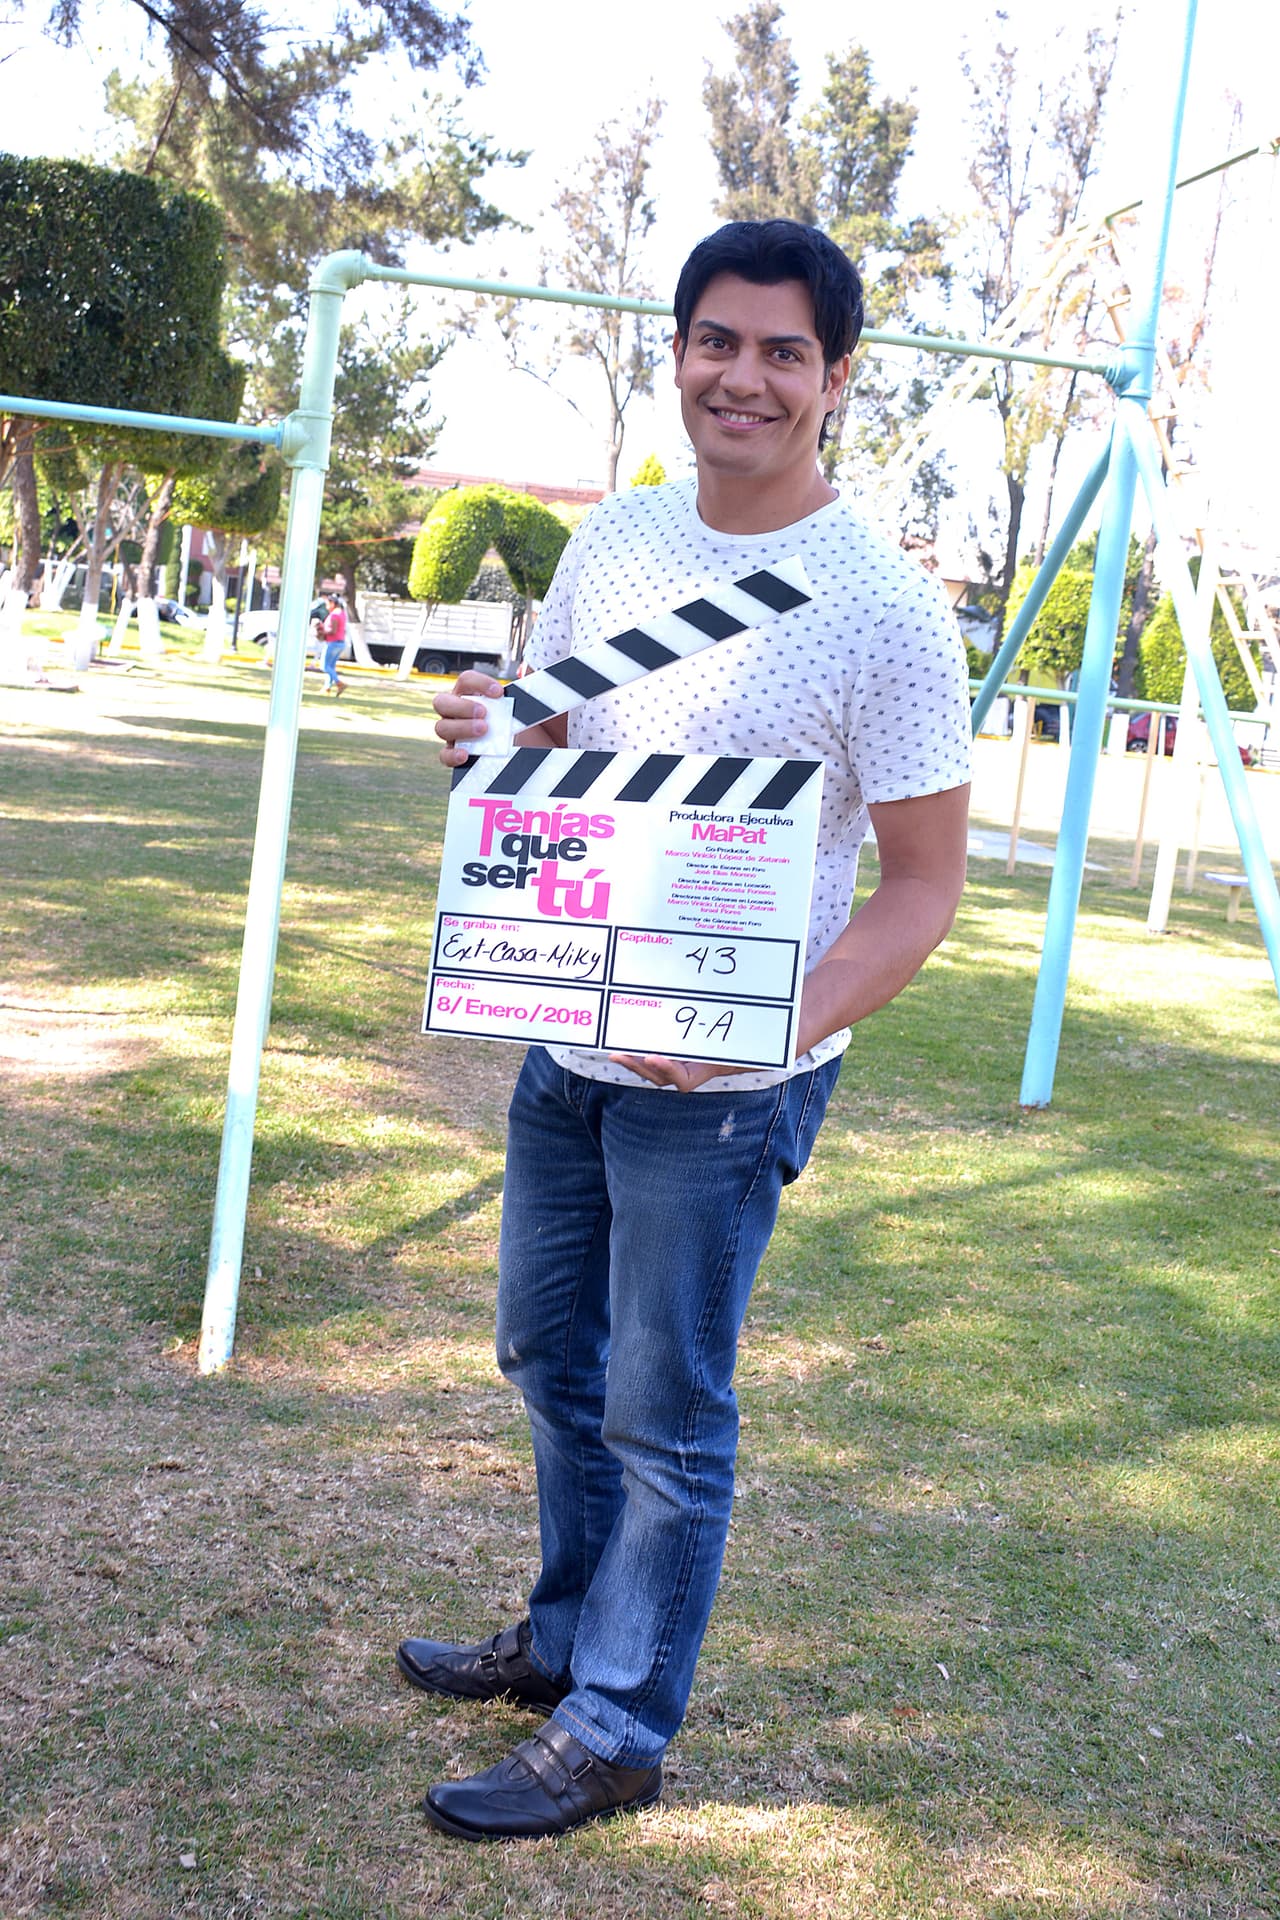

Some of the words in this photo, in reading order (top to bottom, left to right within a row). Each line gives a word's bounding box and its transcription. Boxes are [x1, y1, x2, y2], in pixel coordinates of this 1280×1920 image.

[670, 810, 734, 822] Productora
[740, 814, 794, 826] Ejecutiva
[469, 799, 615, 856] Tenías
[692, 823, 767, 844] MaPat
[501, 833, 587, 865] que
[719, 854, 742, 862] López
[461, 863, 537, 889] ser
[531, 861, 611, 919] tú
[443, 918, 461, 928] Se
[464, 920, 497, 932] graba
[501, 922, 520, 932] en:
[619, 931, 673, 946] Capítulo:
[685, 946, 737, 975] 43
[436, 978, 475, 991] Fecha:
[612, 995, 662, 1008] Escena:
[675, 1006, 734, 1042] 9-A
